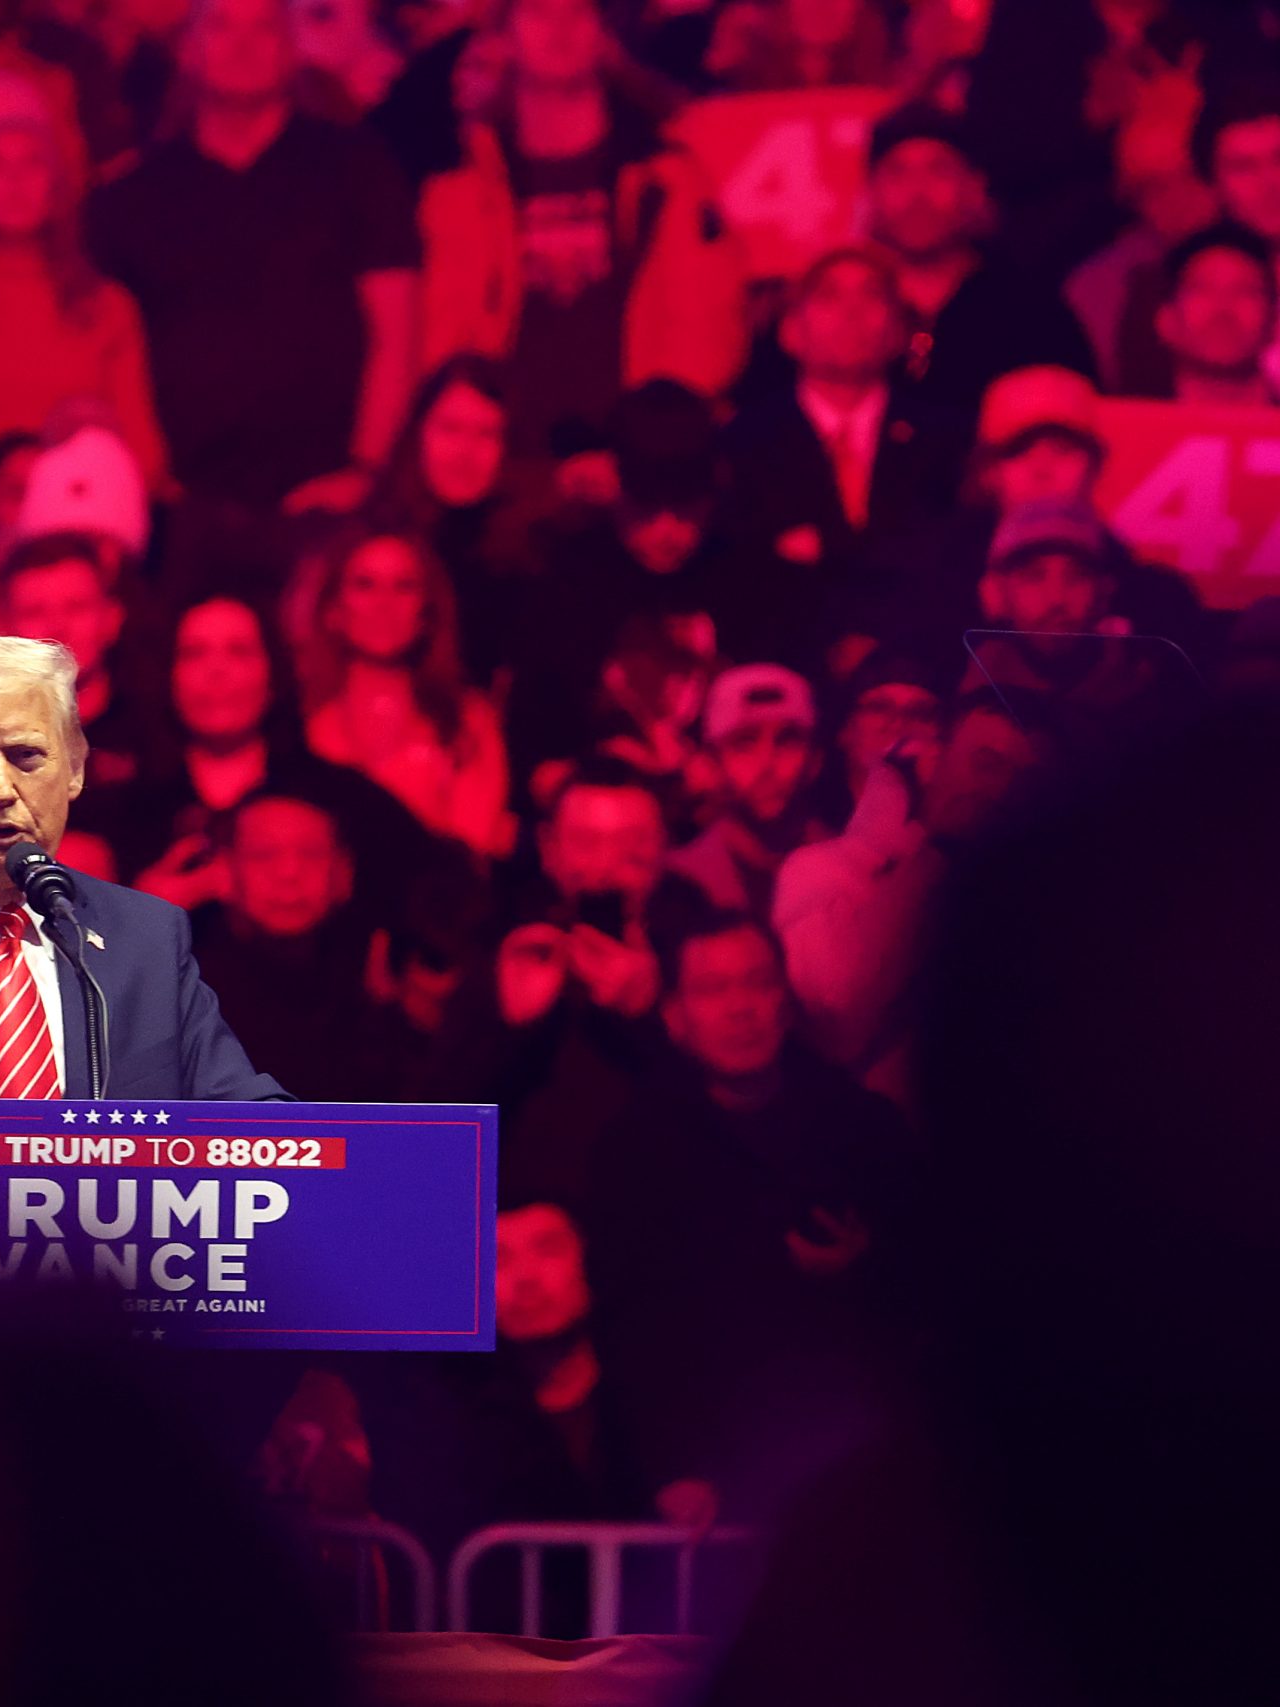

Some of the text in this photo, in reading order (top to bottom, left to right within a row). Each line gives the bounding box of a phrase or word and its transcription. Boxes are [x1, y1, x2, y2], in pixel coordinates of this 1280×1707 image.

[5, 1136, 136, 1164] TRUMP
[145, 1138, 195, 1166] TO
[206, 1138, 321, 1167] 88022
[122, 1299, 266, 1313] GREAT AGAIN!
